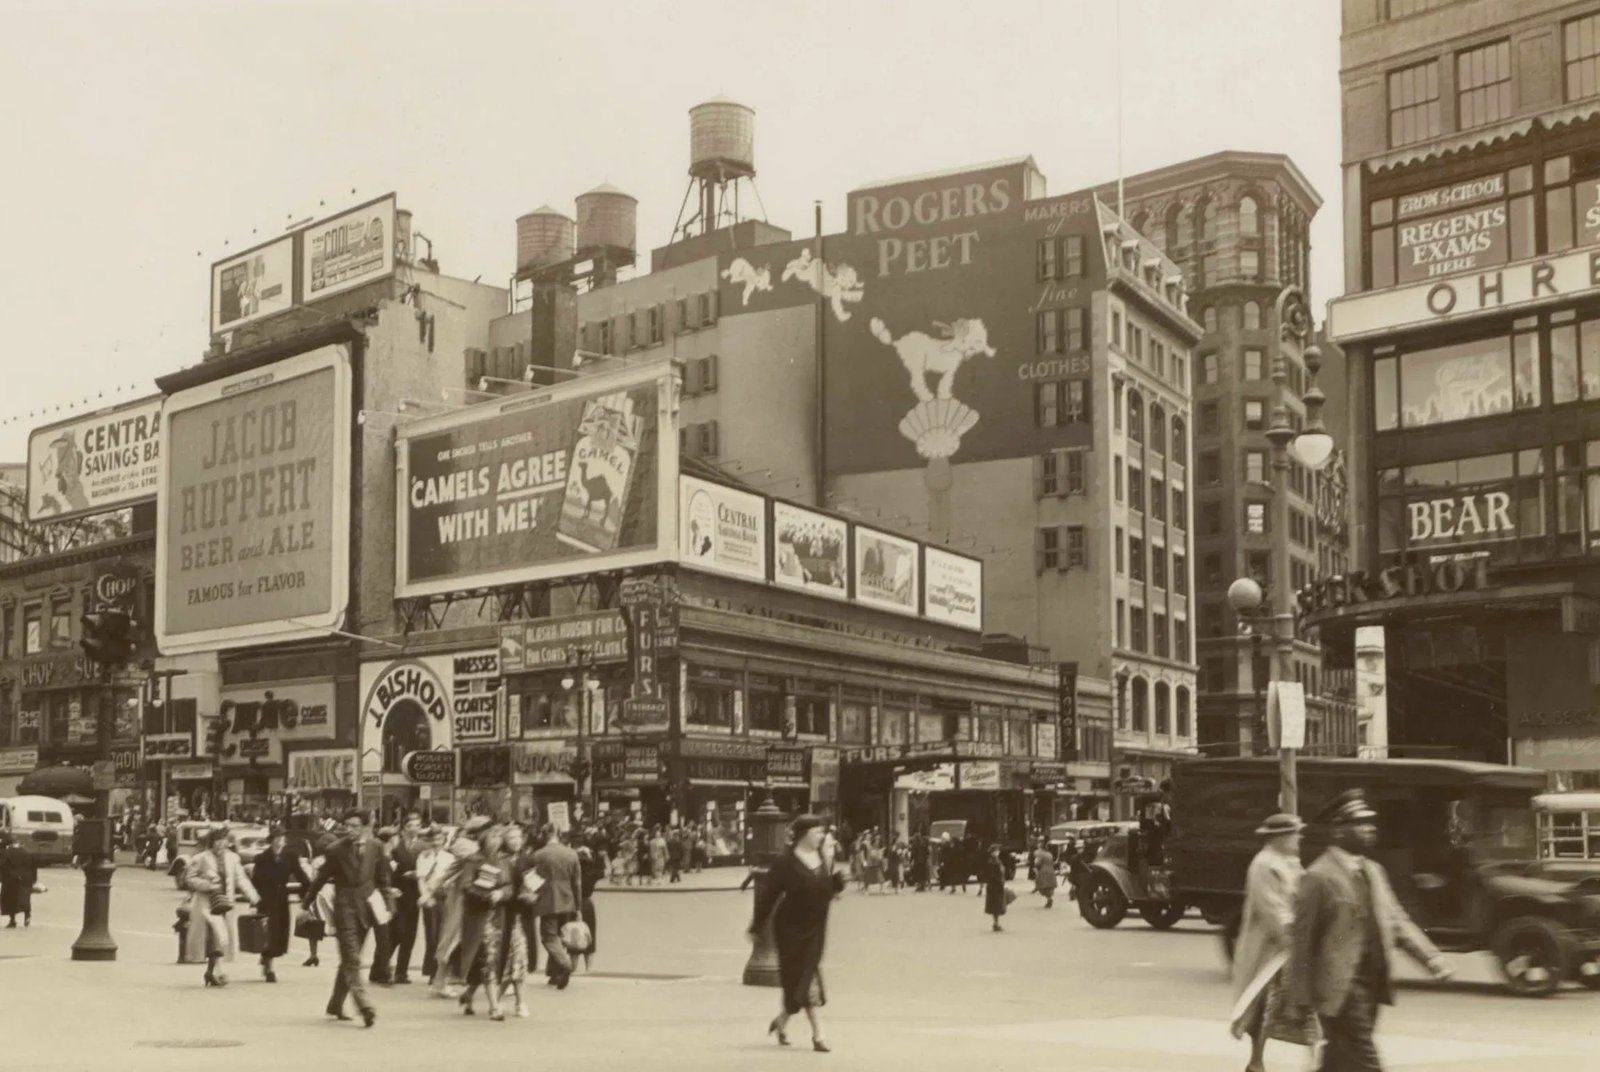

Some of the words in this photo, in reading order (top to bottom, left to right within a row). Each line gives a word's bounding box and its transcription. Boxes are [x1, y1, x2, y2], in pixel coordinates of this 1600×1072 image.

[853, 178, 1010, 237] ROGERS
[1441, 177, 1503, 204] SCHOOL
[1025, 200, 1090, 222] MAKERS
[1401, 207, 1506, 247] REGENTS
[877, 231, 980, 277] PEET
[1412, 232, 1491, 266] EXAMS
[1429, 256, 1476, 276] HERE
[1027, 282, 1077, 314] fine
[1018, 356, 1090, 381] CLOTHES
[84, 411, 160, 454] CENTRA
[203, 399, 297, 471] JACOB
[85, 446, 139, 476] SAVINGS
[144, 440, 160, 462] BA
[497, 450, 566, 489] AGREE
[578, 447, 625, 475] CAMEL
[181, 458, 317, 536] RUPPERT
[438, 508, 489, 545] WITH
[718, 502, 758, 531] CENTRAL
[1408, 491, 1515, 541] BEAR
[181, 537, 234, 571] BEER
[239, 539, 264, 561] and
[268, 521, 315, 556] ALE
[97, 573, 137, 604] CHOP
[188, 582, 234, 605] FAMOUS
[239, 581, 253, 597] for
[258, 571, 306, 594] FLAVOR
[639, 609, 653, 697] FURS
[21, 662, 55, 686] CHOP
[75, 656, 101, 680] SUE
[377, 669, 446, 721] BISHOP
[455, 697, 493, 714] COATS
[455, 715, 492, 733] SUITS
[847, 746, 902, 763] FURS
[968, 742, 993, 758] FURS
